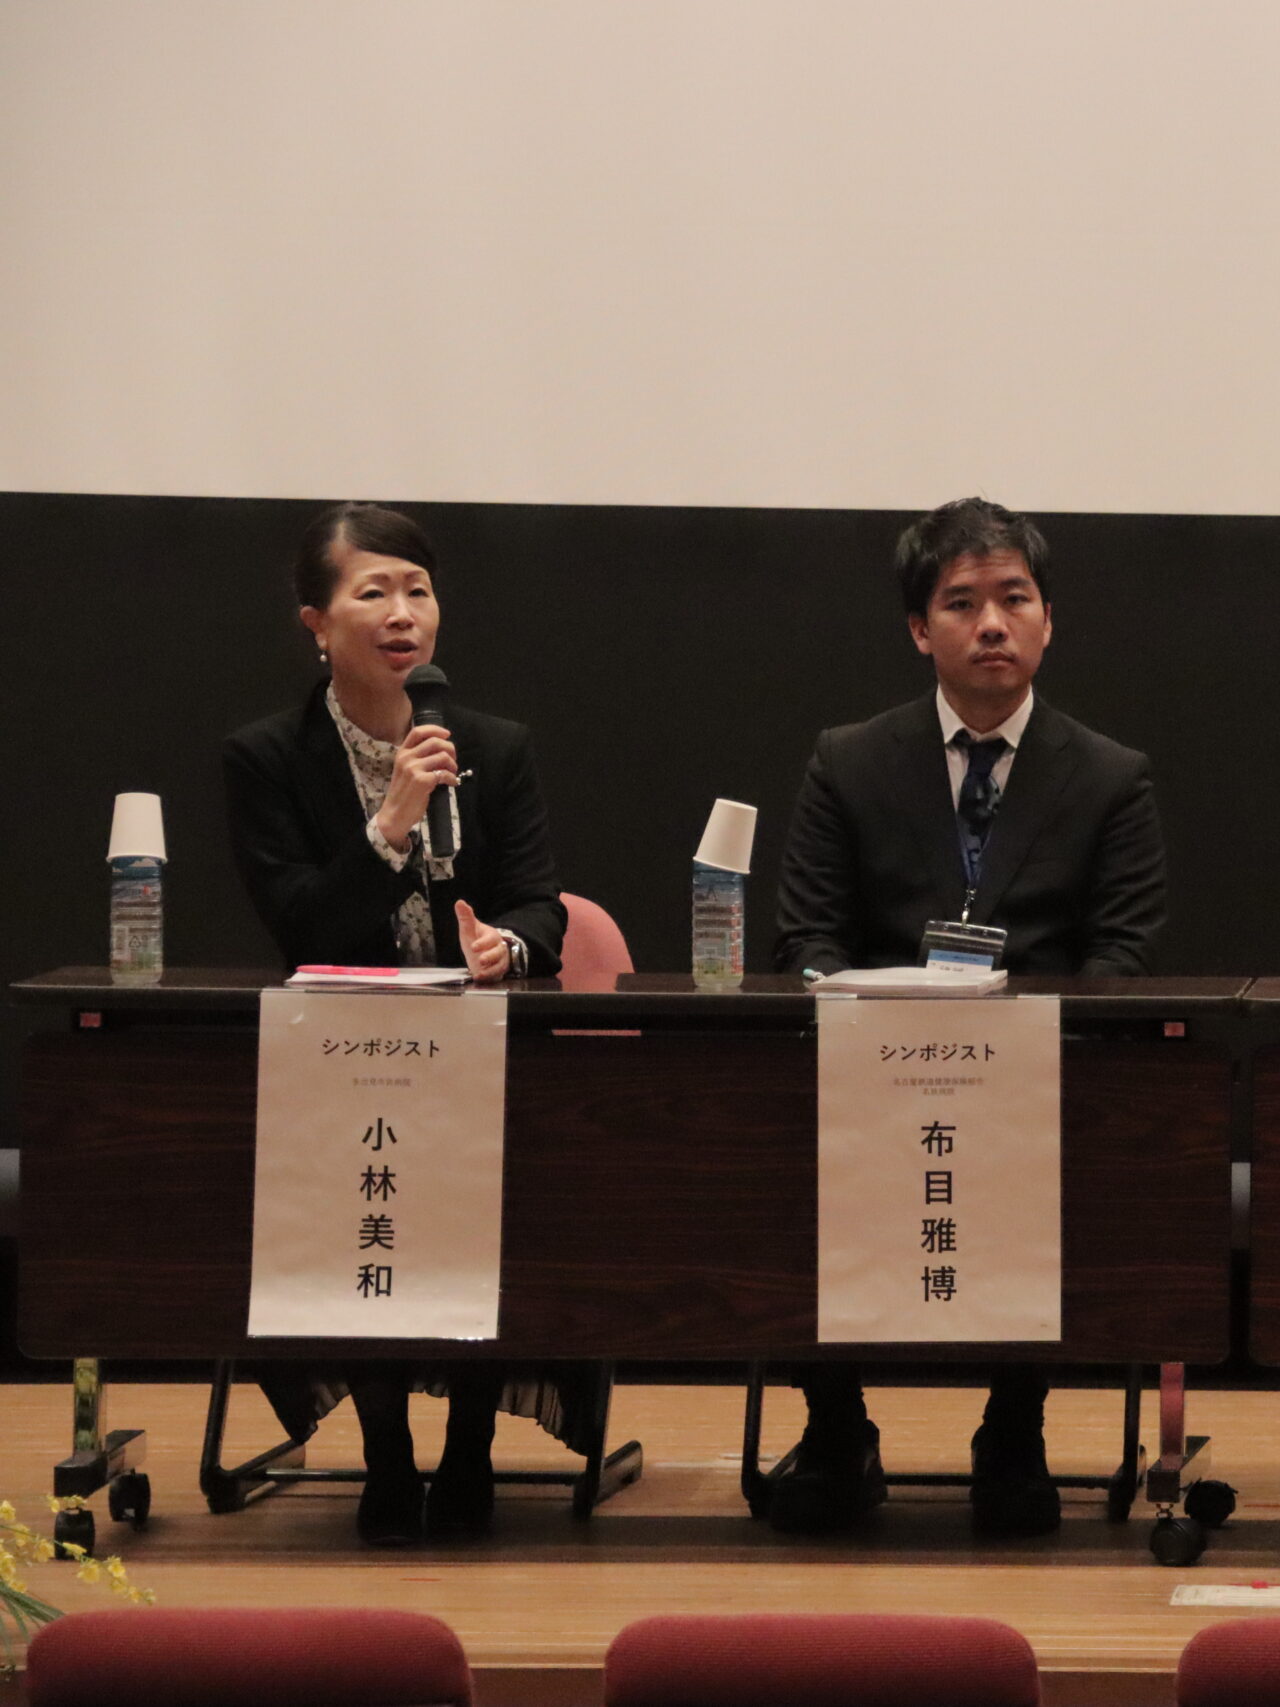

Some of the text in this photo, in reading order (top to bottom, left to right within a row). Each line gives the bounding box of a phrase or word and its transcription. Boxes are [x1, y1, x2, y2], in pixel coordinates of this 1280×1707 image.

[322, 1038, 440, 1058] シンポジスト
[880, 1043, 995, 1062] シンポジスト
[356, 1117, 398, 1298] 小林美和
[920, 1120, 957, 1303] 布目雅博
